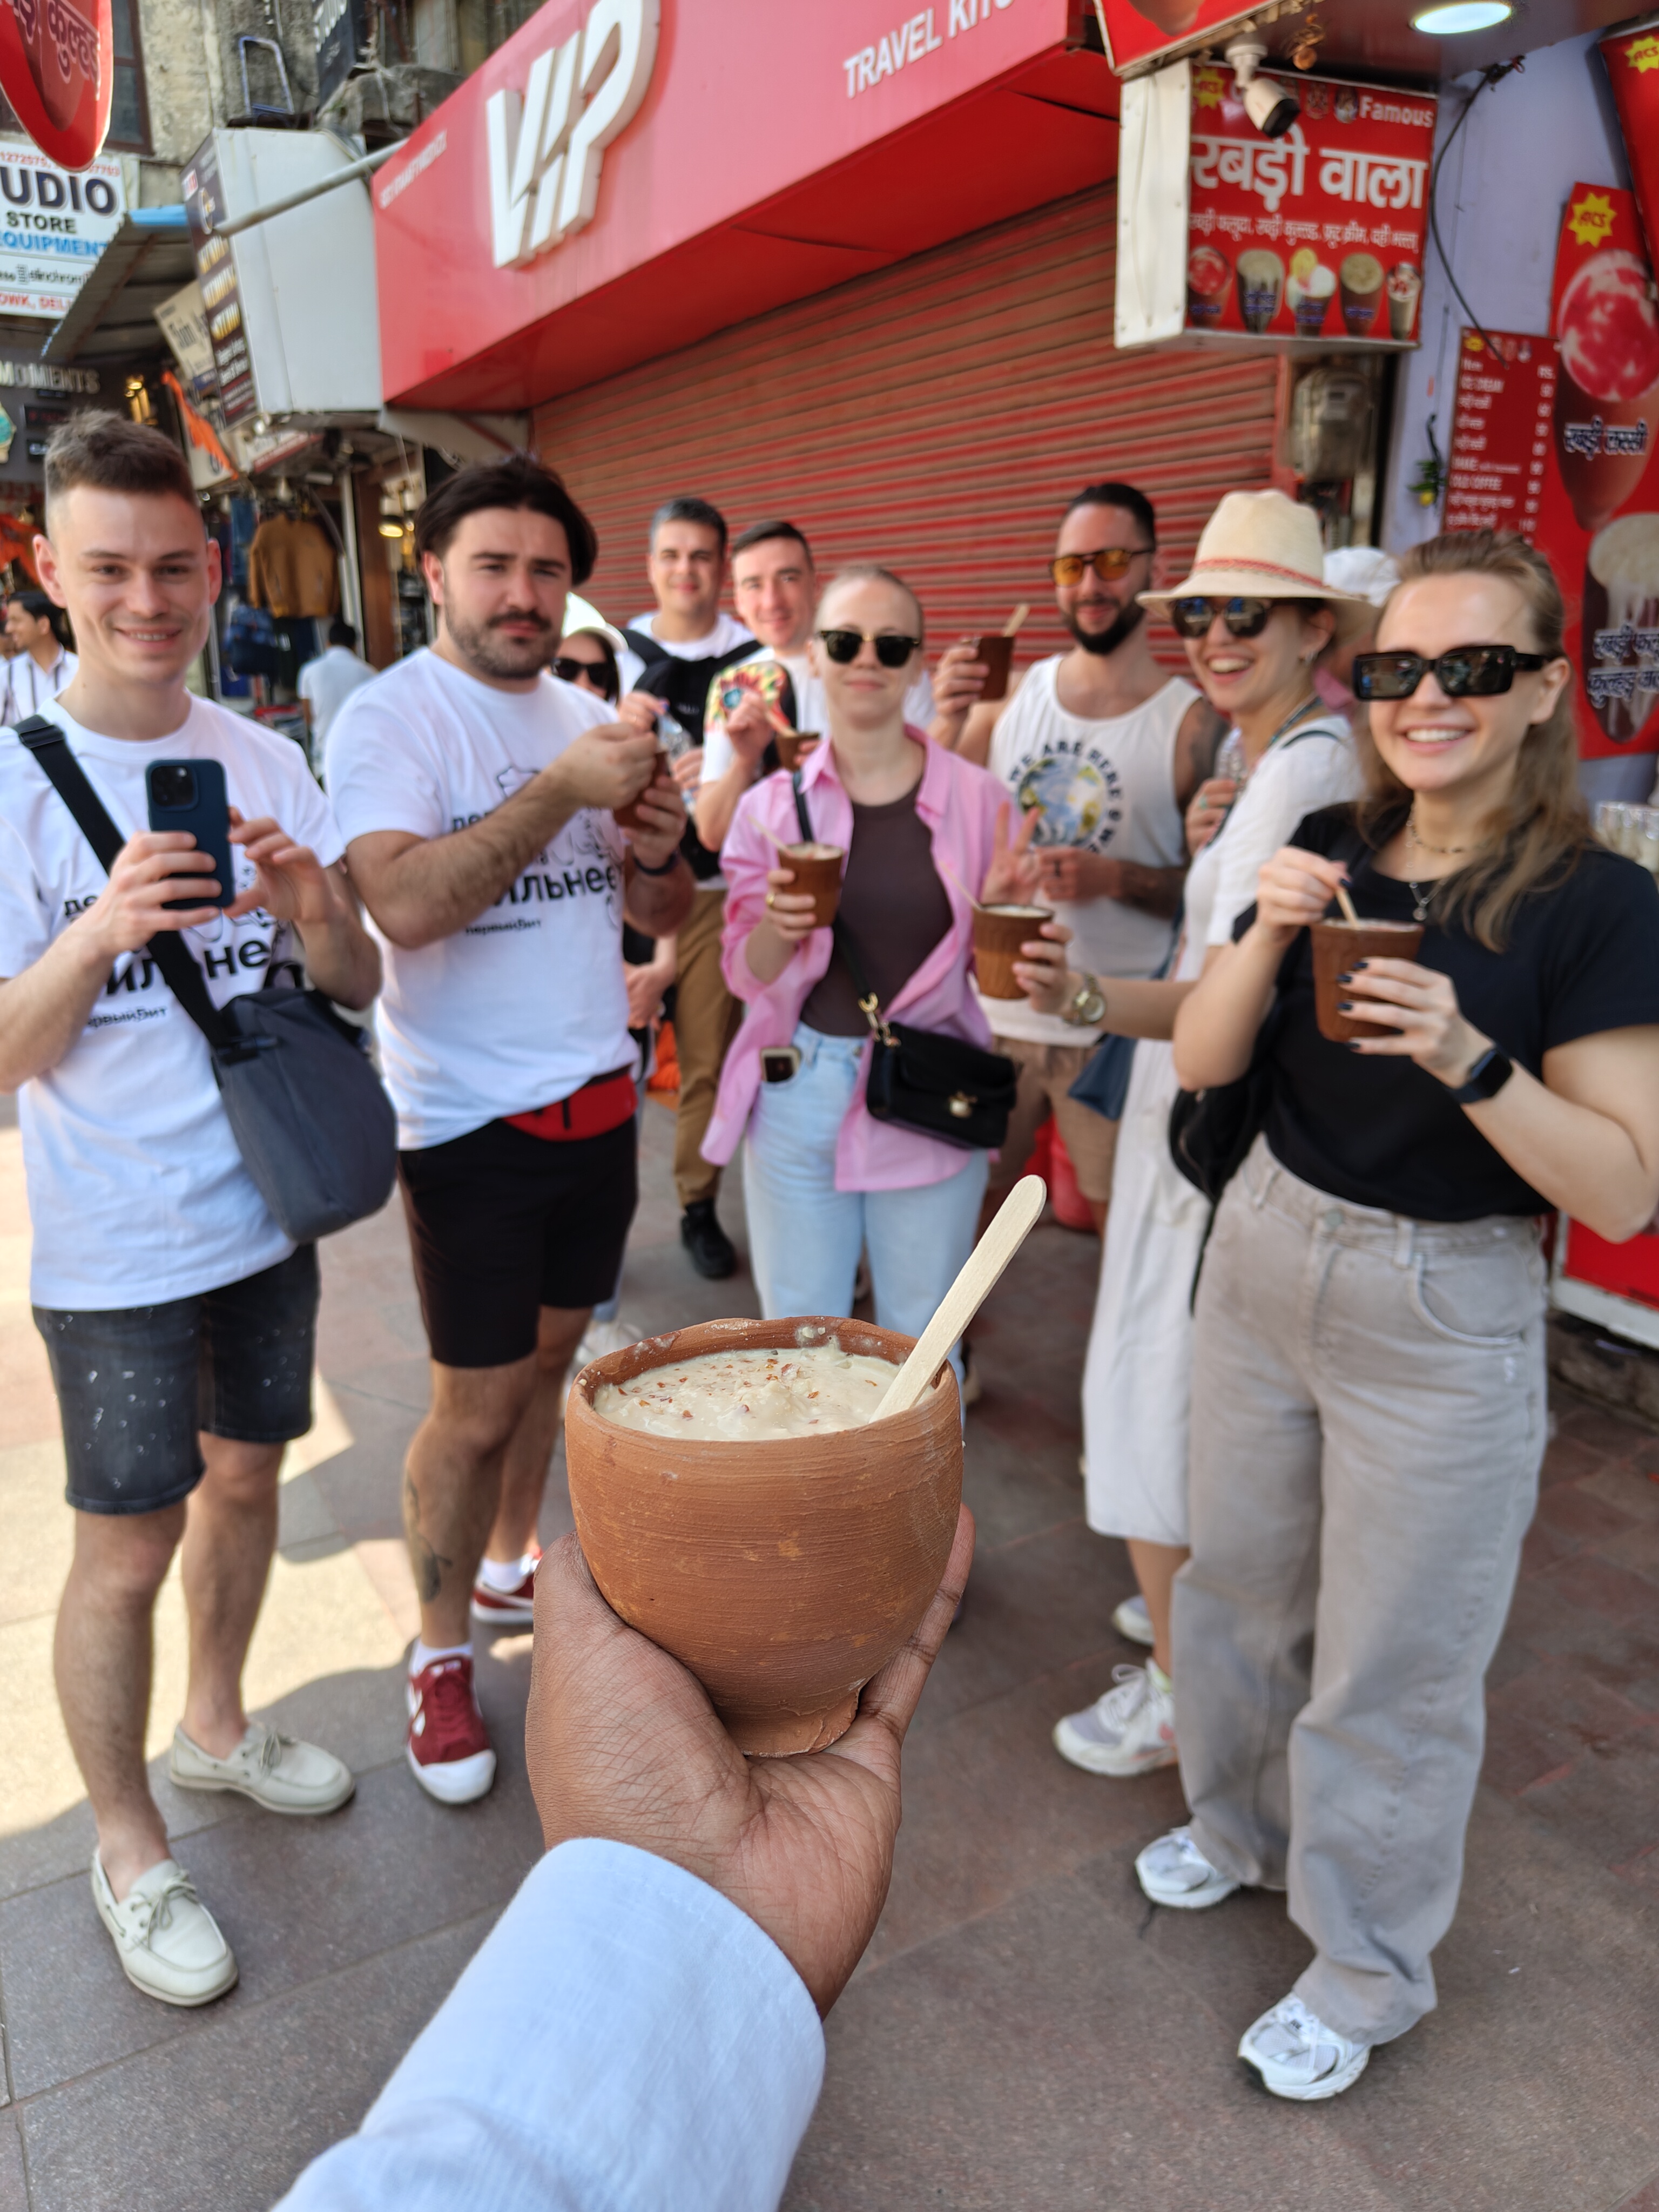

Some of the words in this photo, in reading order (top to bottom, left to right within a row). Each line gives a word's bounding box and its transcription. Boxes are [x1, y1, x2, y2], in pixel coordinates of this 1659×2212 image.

[843, 6, 943, 99] TRAVEL
[486, 0, 656, 268] VIP
[1359, 96, 1434, 128] Famous
[0, 167, 117, 215] UDIO
[1190, 123, 1310, 212] रबड़ी
[1319, 147, 1429, 210] वाला
[0, 230, 108, 256] QUIPMEN
[6, 212, 77, 234] STORE
